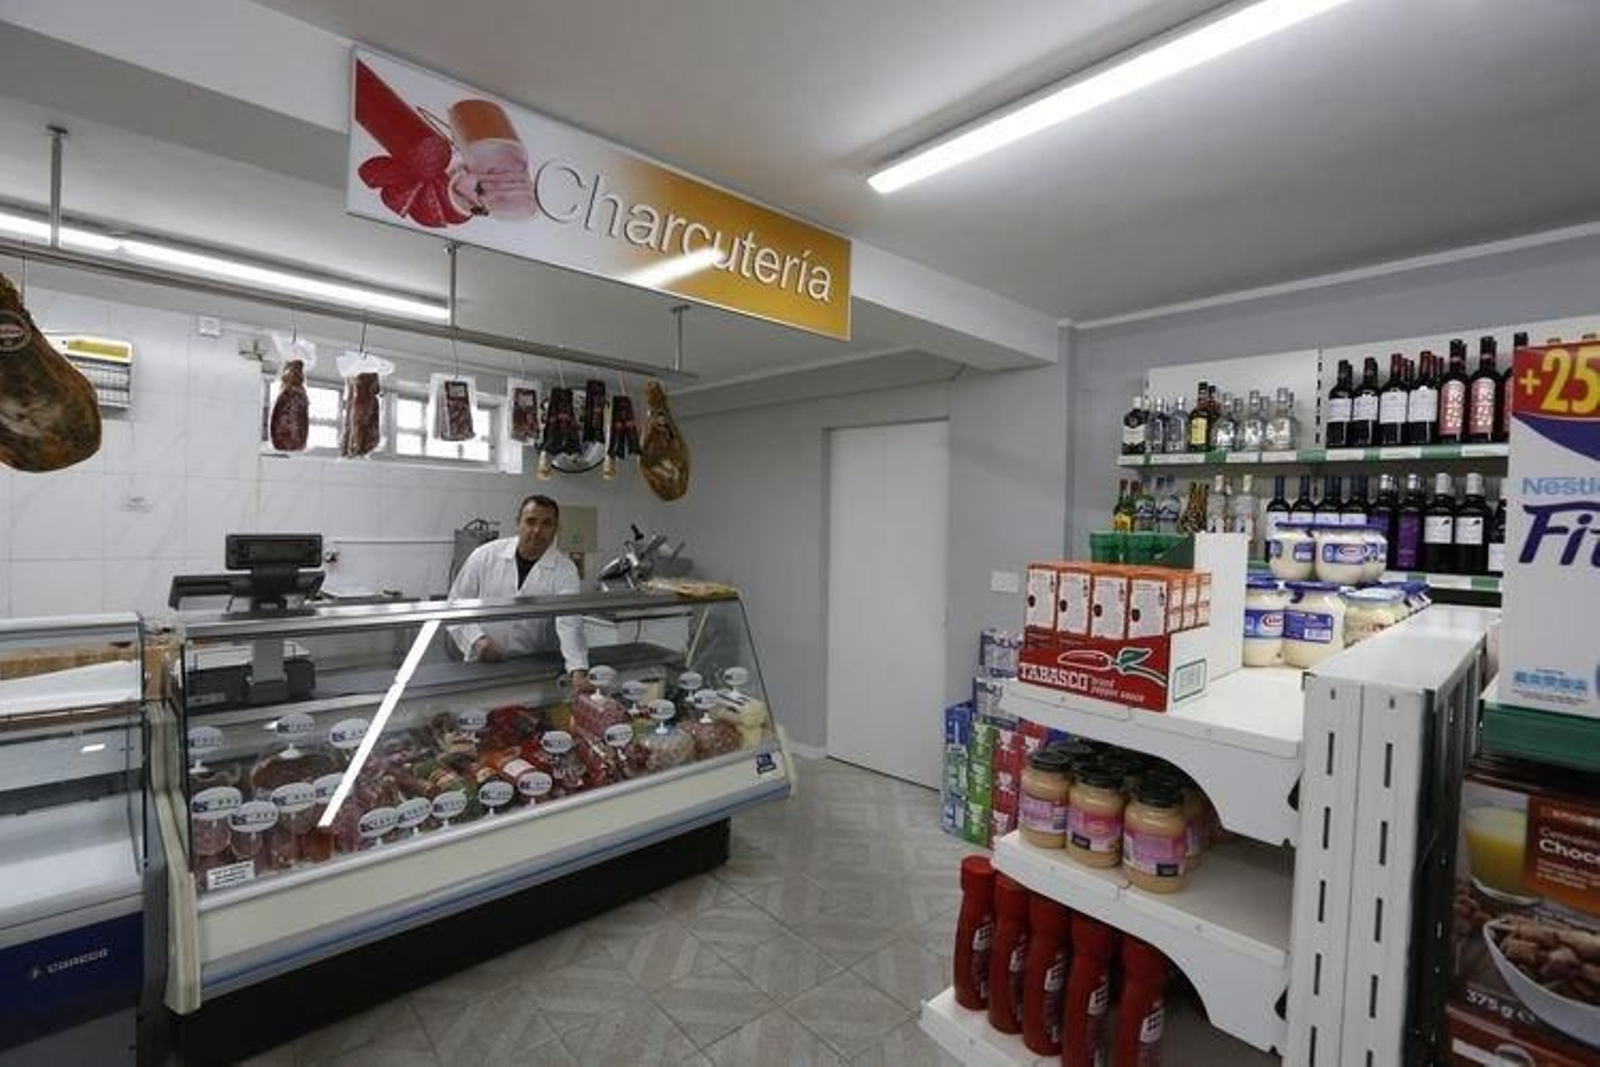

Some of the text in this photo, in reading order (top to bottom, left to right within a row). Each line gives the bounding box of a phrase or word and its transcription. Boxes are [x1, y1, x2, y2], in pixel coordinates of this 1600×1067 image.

[533, 159, 832, 302] Charcutería
[1521, 476, 1600, 496] Nestl
[1020, 662, 1088, 691] TABASCO
[1539, 838, 1600, 866] Choc
